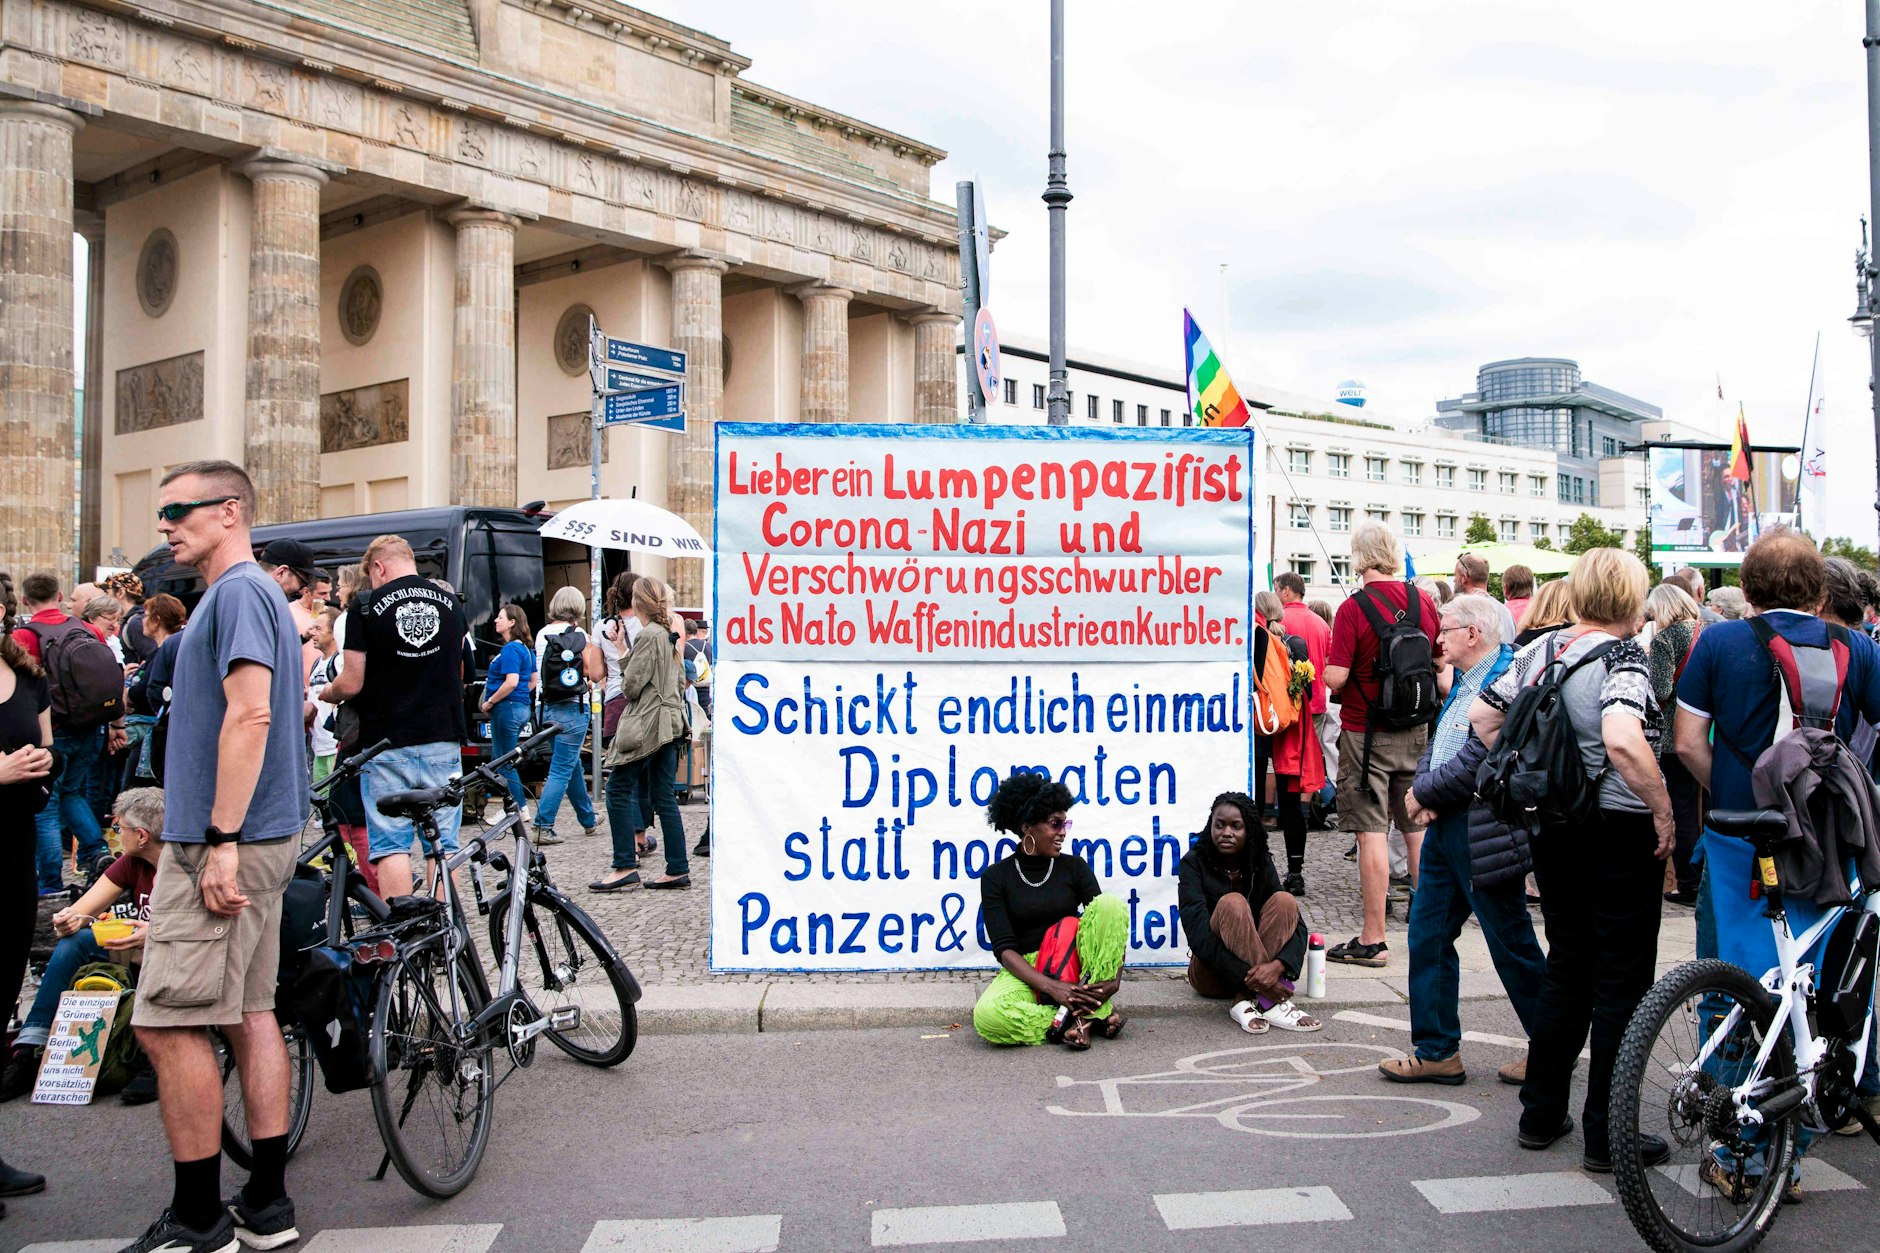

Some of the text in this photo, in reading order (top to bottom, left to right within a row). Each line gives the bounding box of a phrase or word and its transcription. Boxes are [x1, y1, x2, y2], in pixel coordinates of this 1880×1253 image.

[883, 452, 1243, 509] Lumpenpazifist
[610, 529, 663, 548] SIND
[671, 537, 704, 551] WIR
[761, 501, 1143, 555] Corona-Nazi und
[742, 551, 1223, 604] Verschwörungsschwurbler
[373, 587, 453, 616] ELBSCHLOSSKELLER
[725, 603, 774, 646] als
[780, 601, 857, 647] Nato
[731, 671, 1244, 736] Schickt endlich einmal
[783, 816, 910, 882] statt
[933, 837, 1016, 881] noc
[61, 997, 116, 1009] Die einzigen
[57, 1024, 68, 1033] in
[50, 1051, 65, 1061] die
[43, 1065, 84, 1075] uns nicht
[38, 1079, 92, 1090] vorsätzlich
[34, 1092, 90, 1103] verarschen
